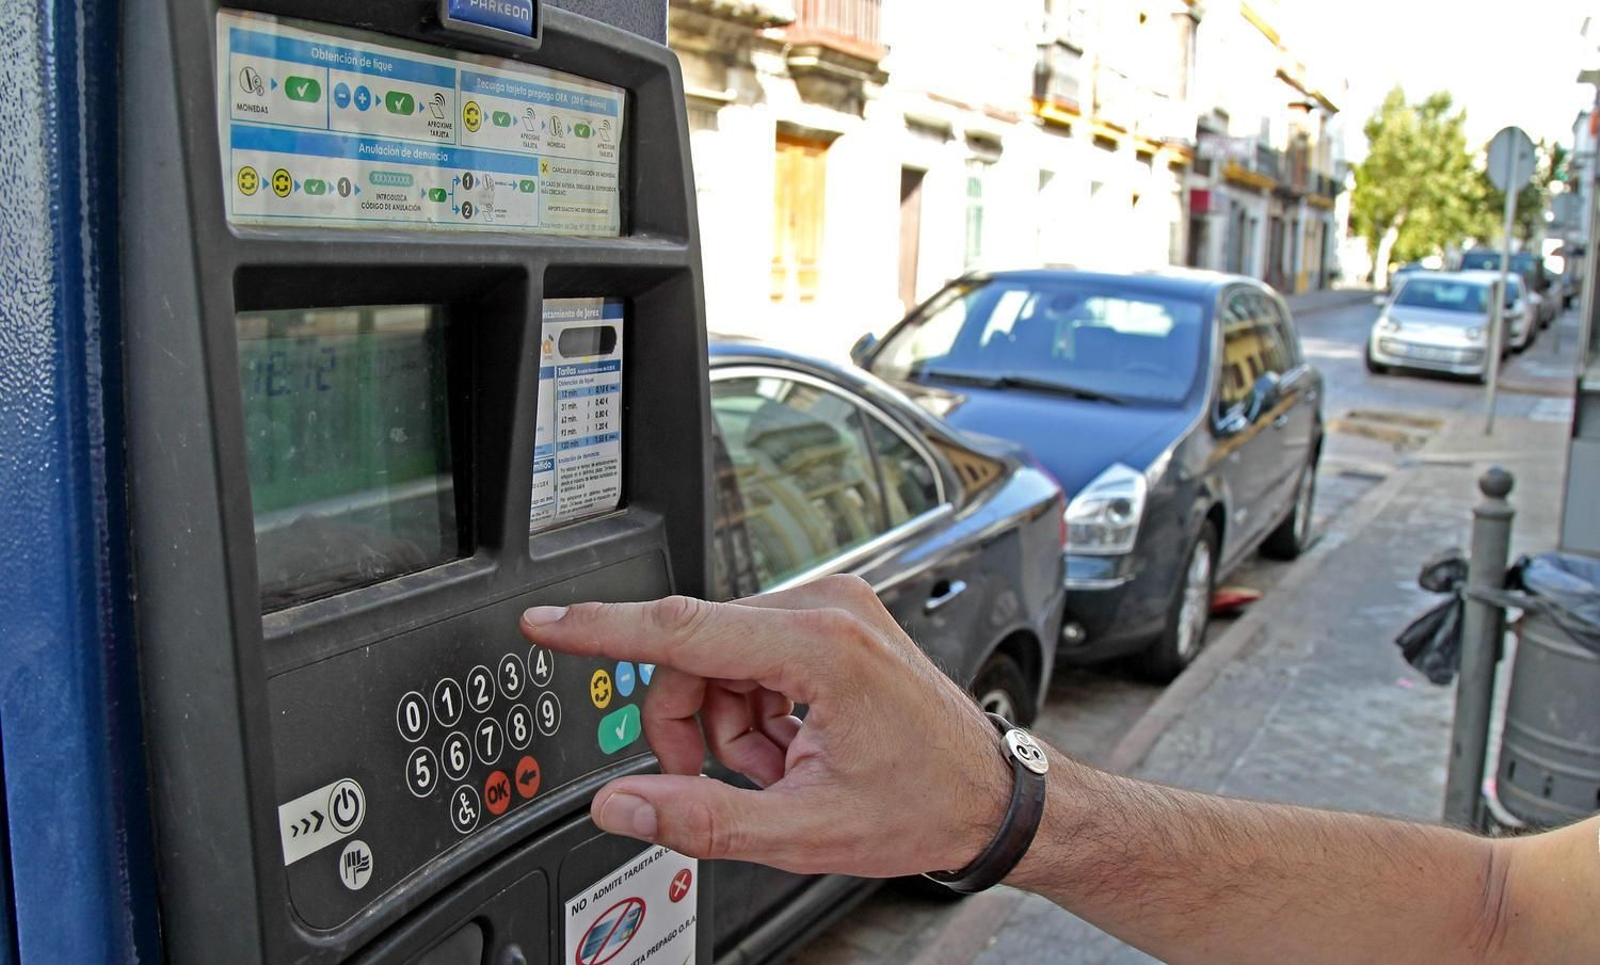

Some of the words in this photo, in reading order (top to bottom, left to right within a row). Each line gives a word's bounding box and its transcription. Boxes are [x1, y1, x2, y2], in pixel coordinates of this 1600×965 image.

[469, 0, 529, 20] PARKEON
[311, 47, 358, 65] Obtención
[360, 56, 372, 67] de
[506, 84, 527, 98] tarjeta
[528, 89, 554, 103] prepago
[237, 103, 269, 114] MONEDAS
[428, 120, 452, 130] APROXIME
[430, 130, 449, 138] TARJETA
[359, 143, 400, 157] Anulación
[401, 147, 412, 158] de
[413, 149, 449, 161] denuncia
[342, 181, 347, 194] 1
[361, 201, 384, 210] CÓDIGO
[385, 203, 391, 211] DE
[392, 203, 422, 212] ANULACIÓN
[464, 205, 471, 216] 2
[576, 308, 584, 318] de
[584, 307, 599, 319] Jerez
[406, 701, 421, 732] 0
[442, 687, 454, 717] 1
[474, 675, 489, 705] 2
[505, 662, 518, 691] 3
[536, 650, 548, 677] 4
[416, 755, 431, 787] 5
[450, 741, 464, 772] 6
[481, 726, 495, 756] 7
[513, 713, 526, 741] 8
[542, 700, 554, 727] 9
[487, 780, 508, 805] OK
[571, 898, 588, 917] NO
[592, 875, 623, 903] ADMITE
[624, 856, 654, 881] TARJETA
[654, 847, 664, 861] DE
[646, 929, 678, 958] PREPAGO
